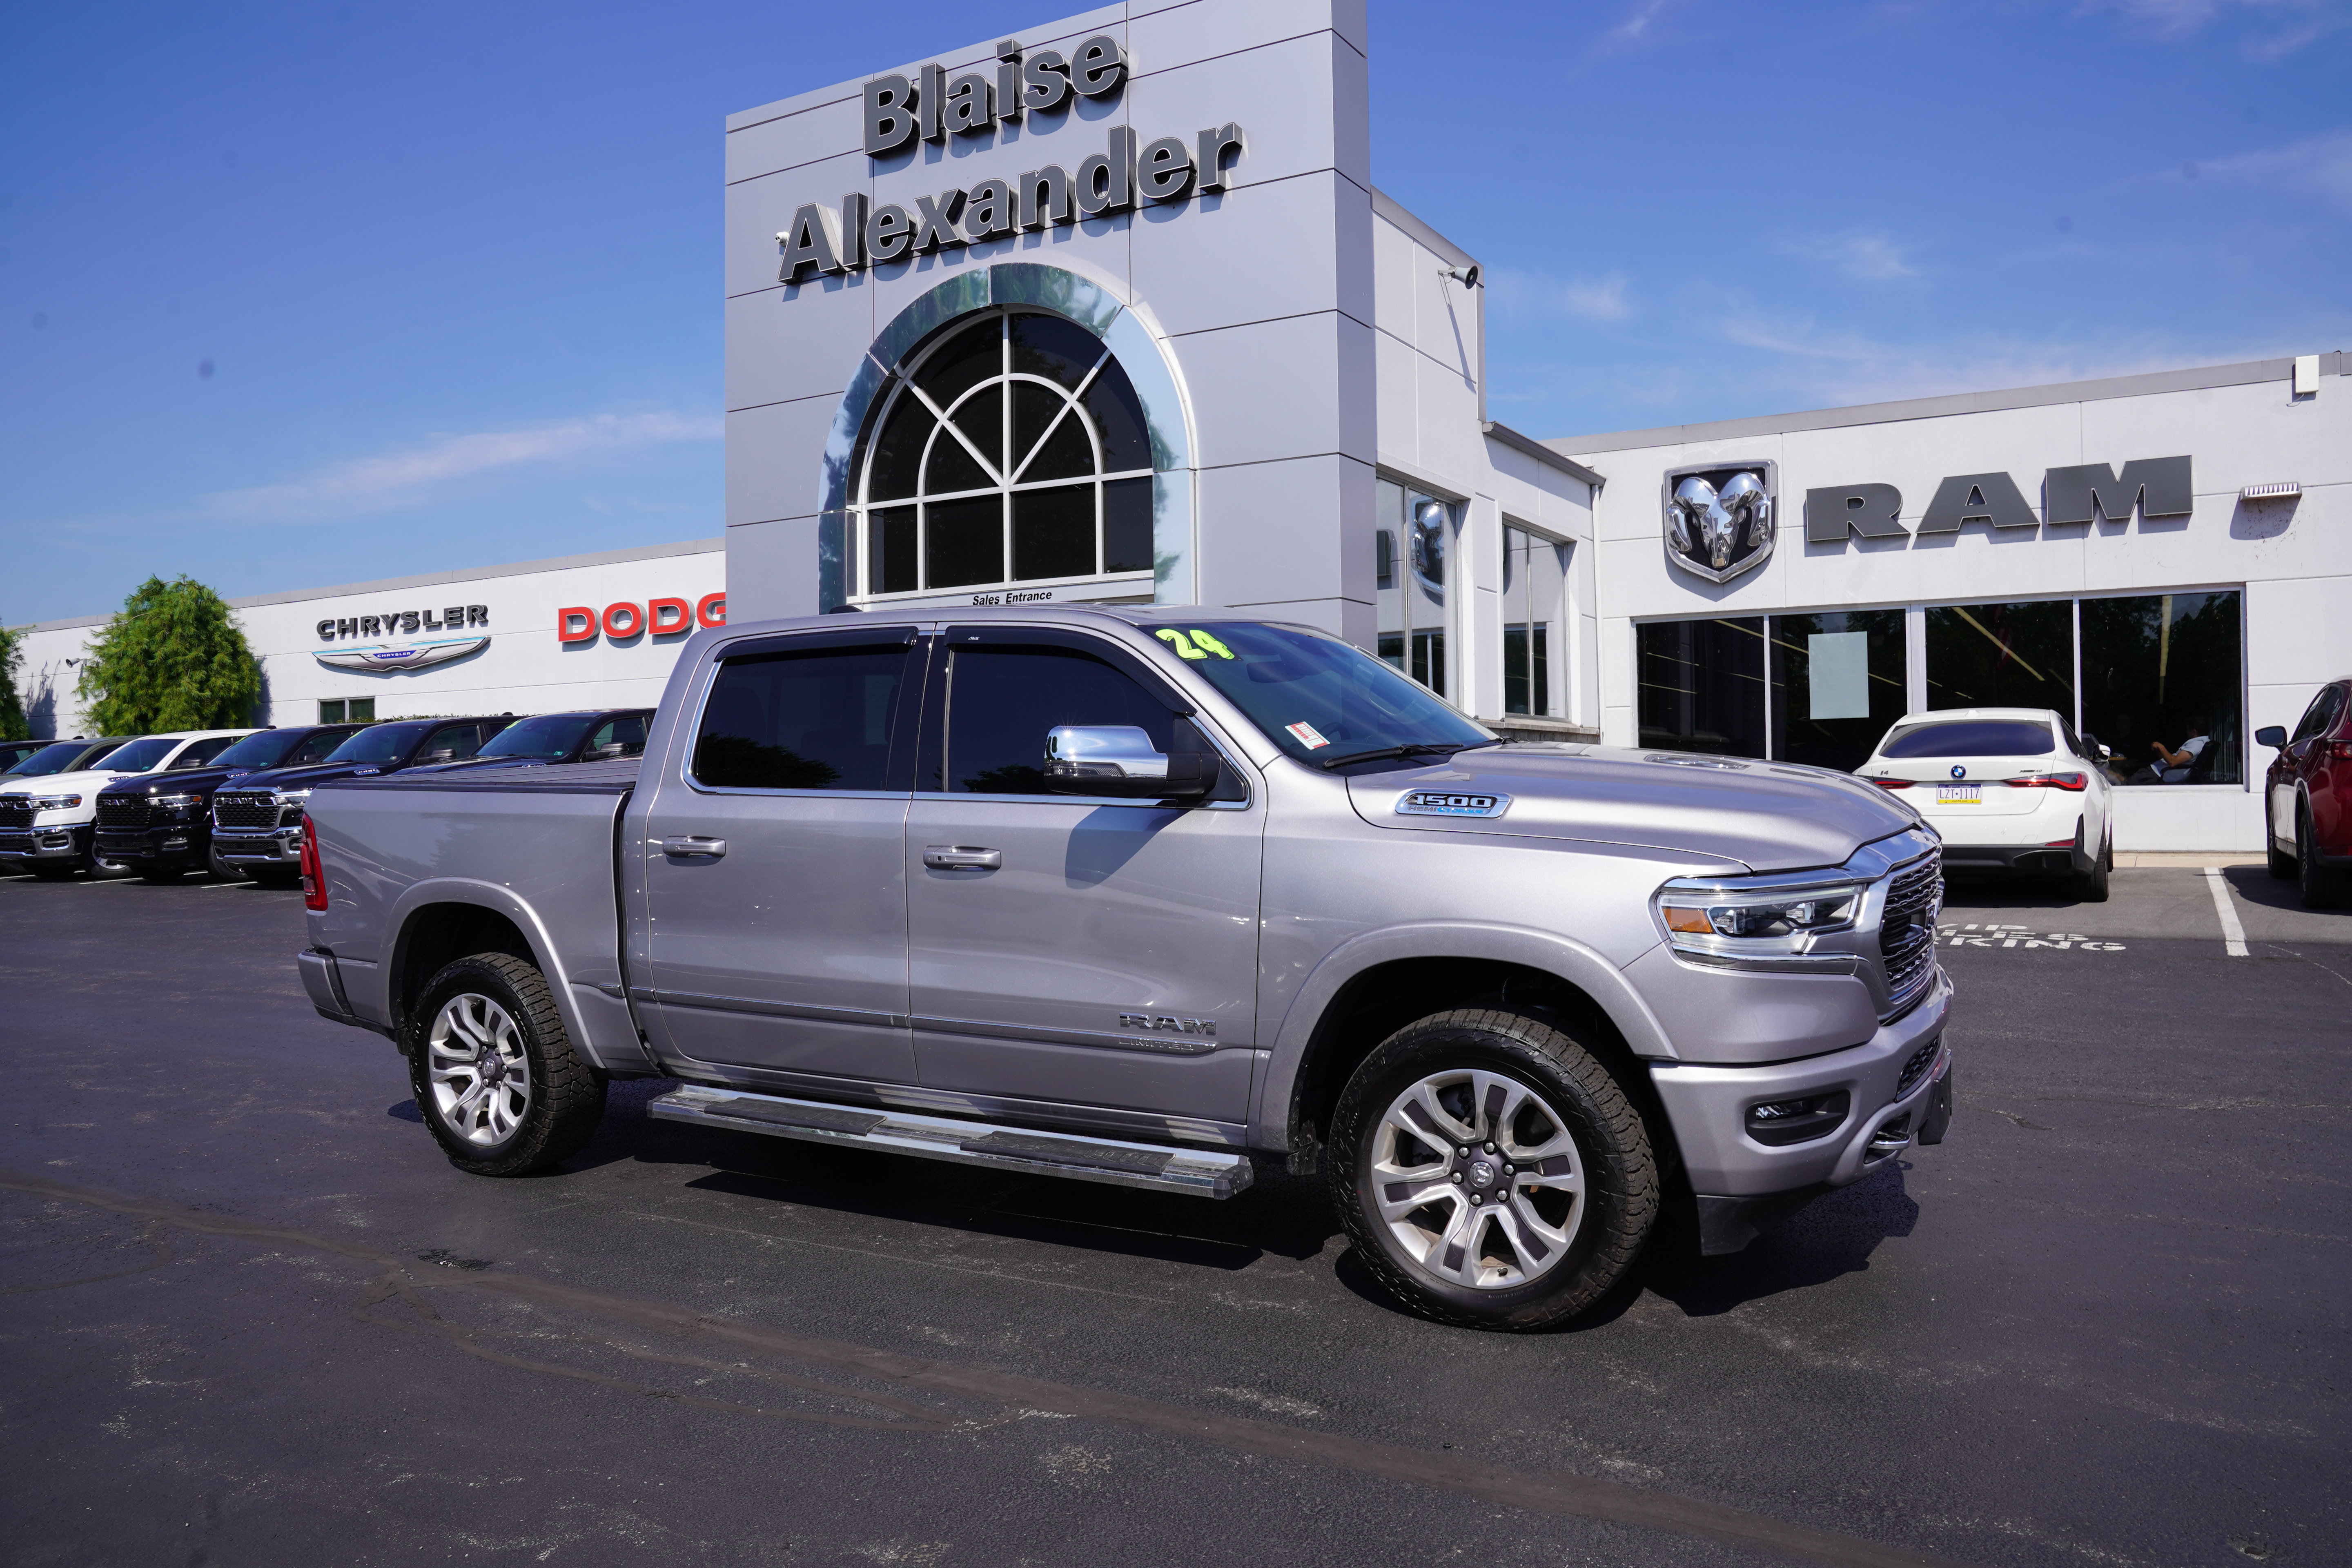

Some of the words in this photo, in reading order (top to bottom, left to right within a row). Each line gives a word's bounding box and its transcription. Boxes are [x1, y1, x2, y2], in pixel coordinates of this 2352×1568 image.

[862, 34, 1126, 158] Blaise
[777, 122, 1242, 284] Alexander
[1805, 455, 2193, 542] RAM
[973, 595, 1000, 605] Sales
[1006, 591, 1052, 604] Entrance
[316, 604, 489, 637] CHRYSLER
[558, 592, 726, 642] DODG
[1155, 628, 1235, 660] 24
[1406, 795, 1492, 807] 1500
[1933, 936, 2126, 951] KING
[1940, 929, 2089, 941] LES
[1119, 1011, 1216, 1036] RAM
[1119, 1038, 1194, 1051] LIMITED
